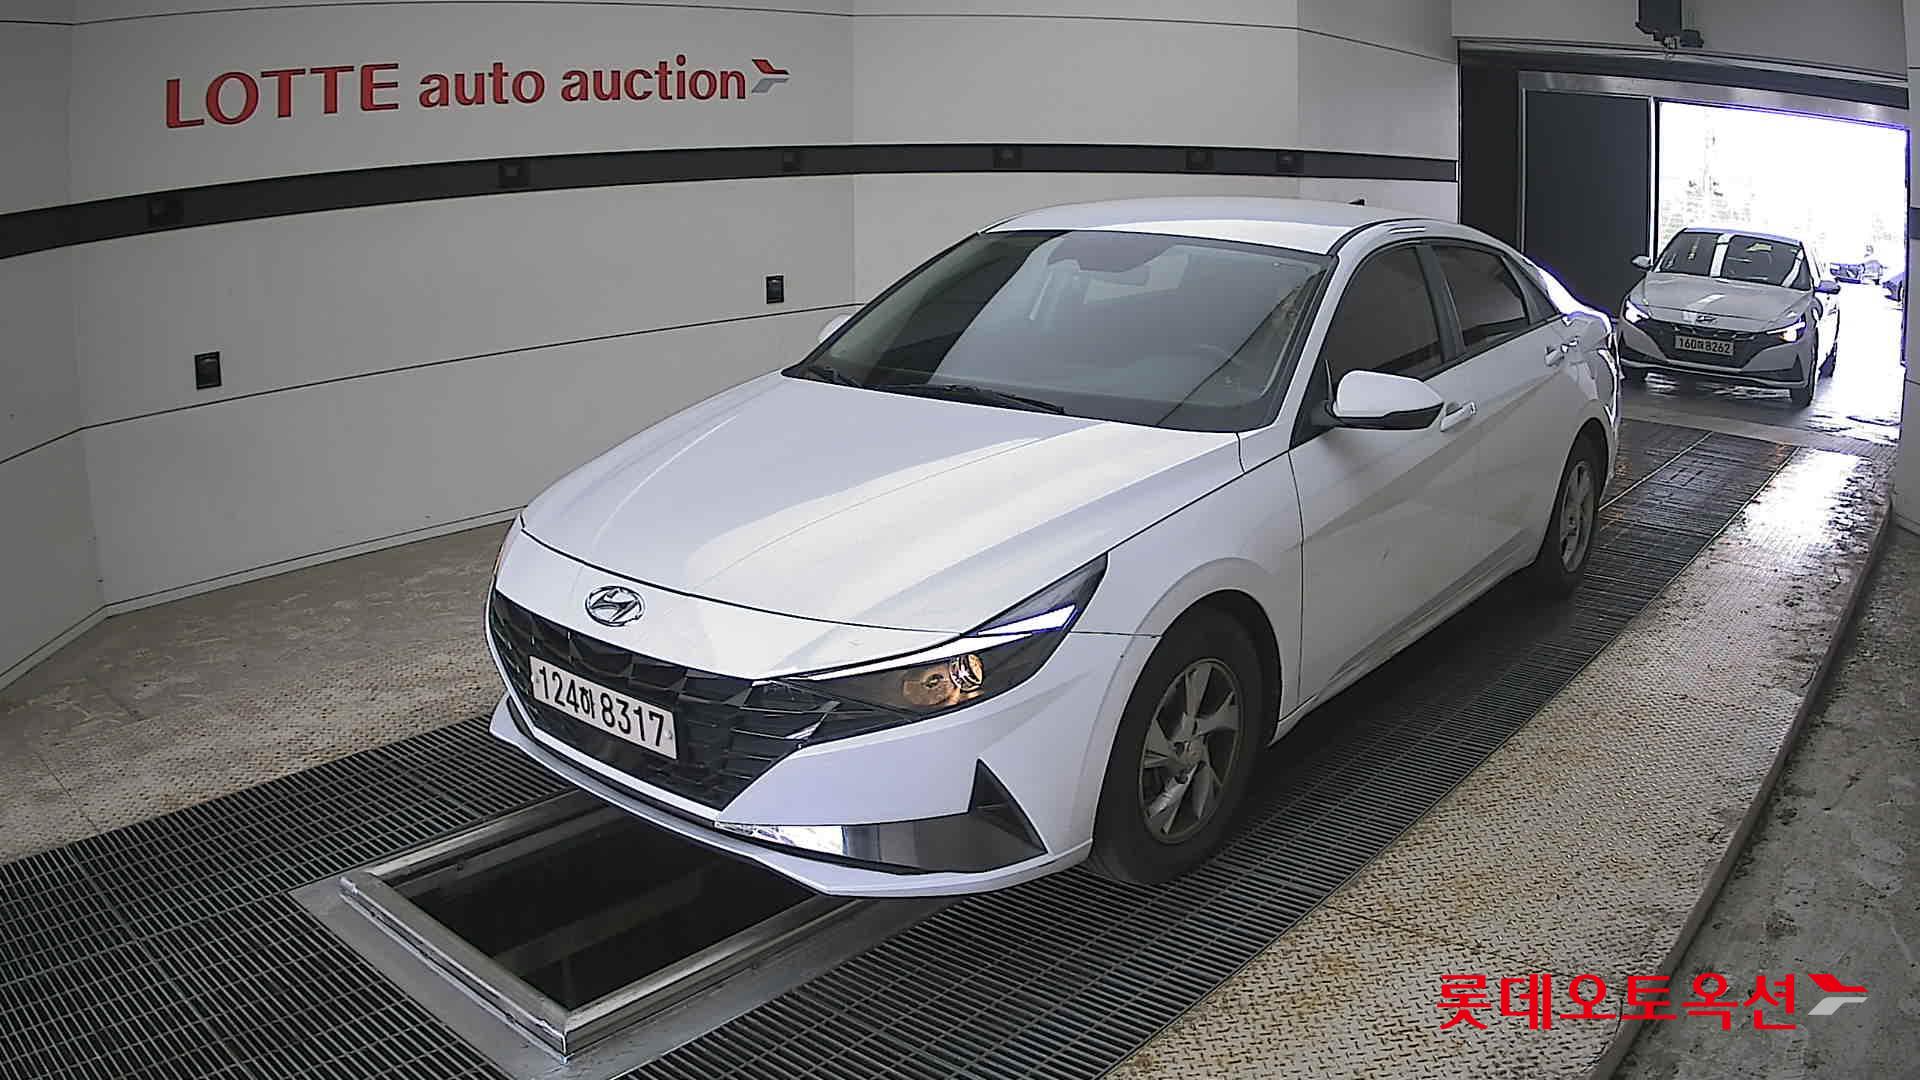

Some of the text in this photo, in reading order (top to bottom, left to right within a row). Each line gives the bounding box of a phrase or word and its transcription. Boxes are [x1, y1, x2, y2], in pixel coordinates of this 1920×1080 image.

[165, 54, 747, 129] LOTTE auto auction
